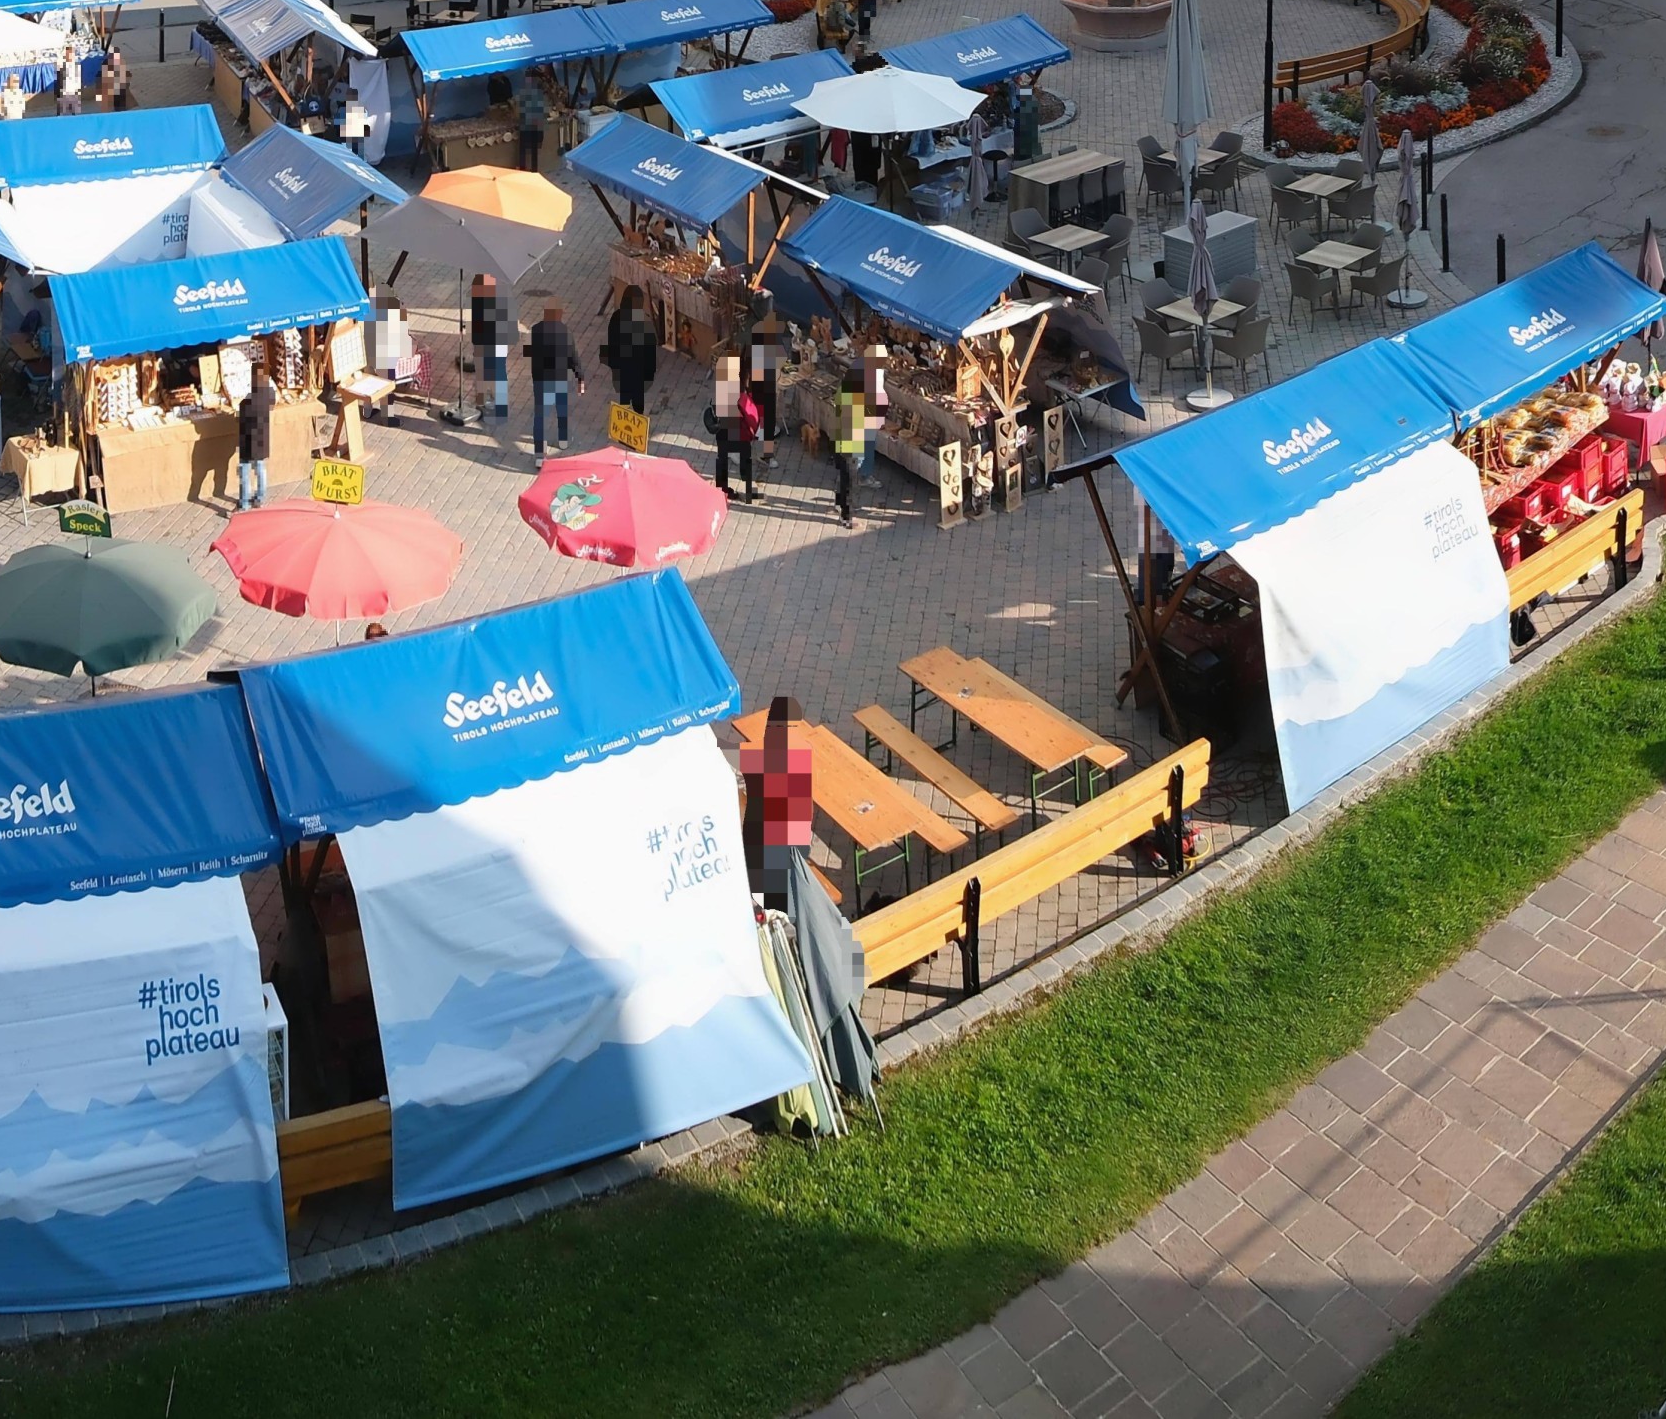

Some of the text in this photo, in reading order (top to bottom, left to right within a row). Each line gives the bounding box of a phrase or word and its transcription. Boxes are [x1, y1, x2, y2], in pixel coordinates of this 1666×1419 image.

[660, 6, 702, 22] Seefeld
[485, 33, 530, 50] Seefeld
[956, 46, 997, 64] Seefeld
[742, 83, 790, 103] Seefeld
[73, 137, 133, 154] Seefeld
[638, 156, 683, 182] Seefeld
[868, 246, 923, 279] Seefeld
[173, 278, 247, 306] Seefeld
[1509, 308, 1567, 347] Seefeld
[616, 410, 643, 429] BRAT
[612, 423, 646, 447] WURST
[1262, 417, 1332, 466] Seefeld
[322, 465, 357, 480] BRAT
[315, 479, 360, 500] WURST
[67, 502, 102, 518] Rasler
[69, 519, 102, 532] Speck
[443, 670, 554, 729] Seefeld
[452, 706, 560, 743] TIROLS HOCHPLATEAU
[69, 877, 99, 893] Seefeld
[110, 870, 147, 887] Leutasch
[199, 857, 221, 872] Reith
[230, 849, 269, 868] Scharnitz
[138, 973, 221, 1010] #tirols
[158, 996, 220, 1031] hoch
[145, 1021, 241, 1066] plateau
